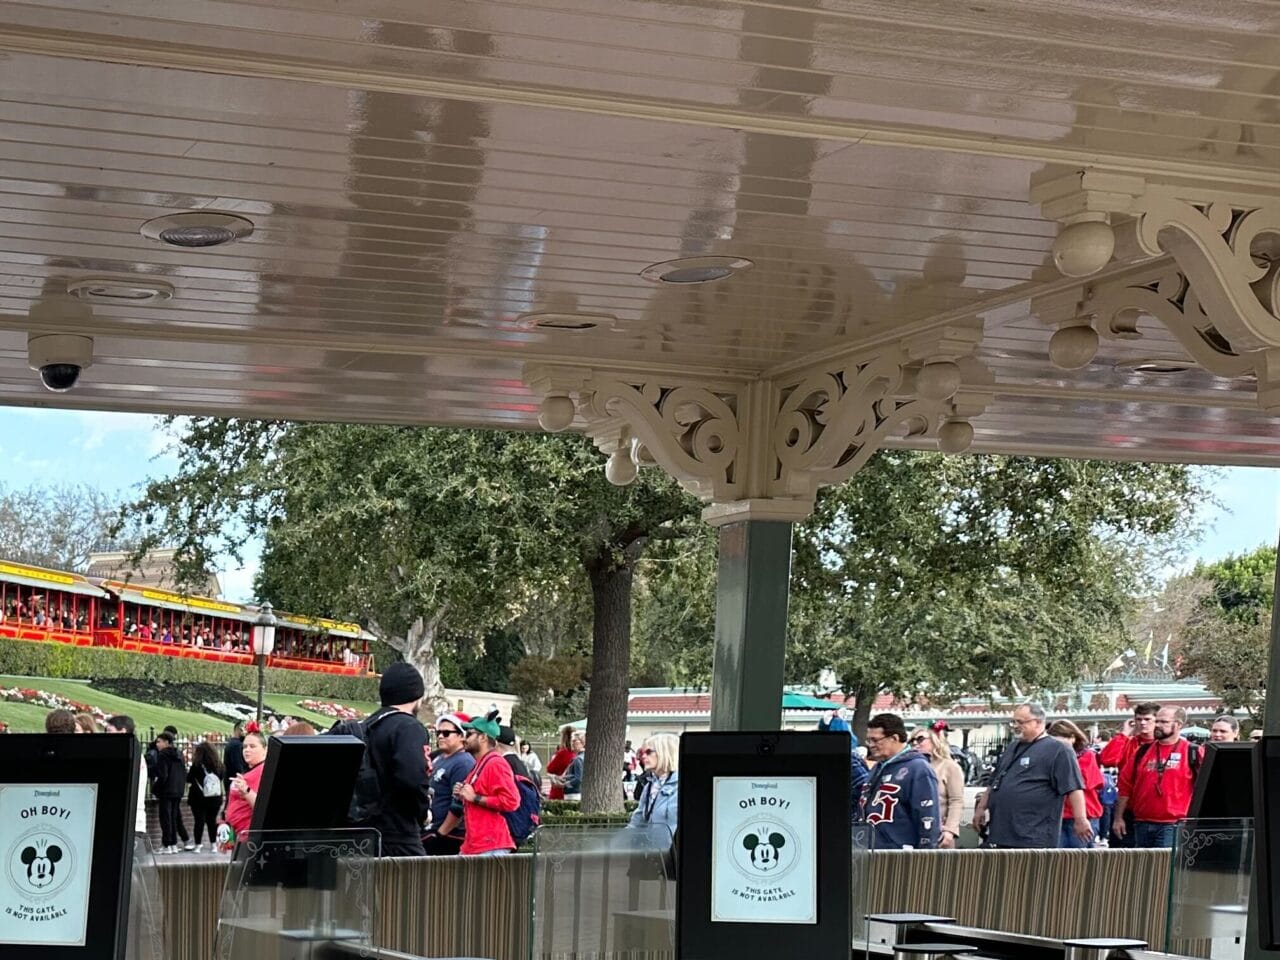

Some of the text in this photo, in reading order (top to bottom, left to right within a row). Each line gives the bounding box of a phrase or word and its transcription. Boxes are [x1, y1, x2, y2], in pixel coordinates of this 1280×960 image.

[739, 796, 791, 810] OH BOY!
[20, 805, 71, 820] OH BOY!
[740, 892, 754, 901] NOT
[757, 889, 796, 902] AVAILABLE
[745, 886, 783, 895] THIS GATE
[13, 911, 28, 920] NOT
[30, 908, 68, 921] AVAILABLE
[20, 904, 55, 914] THIS GATE
